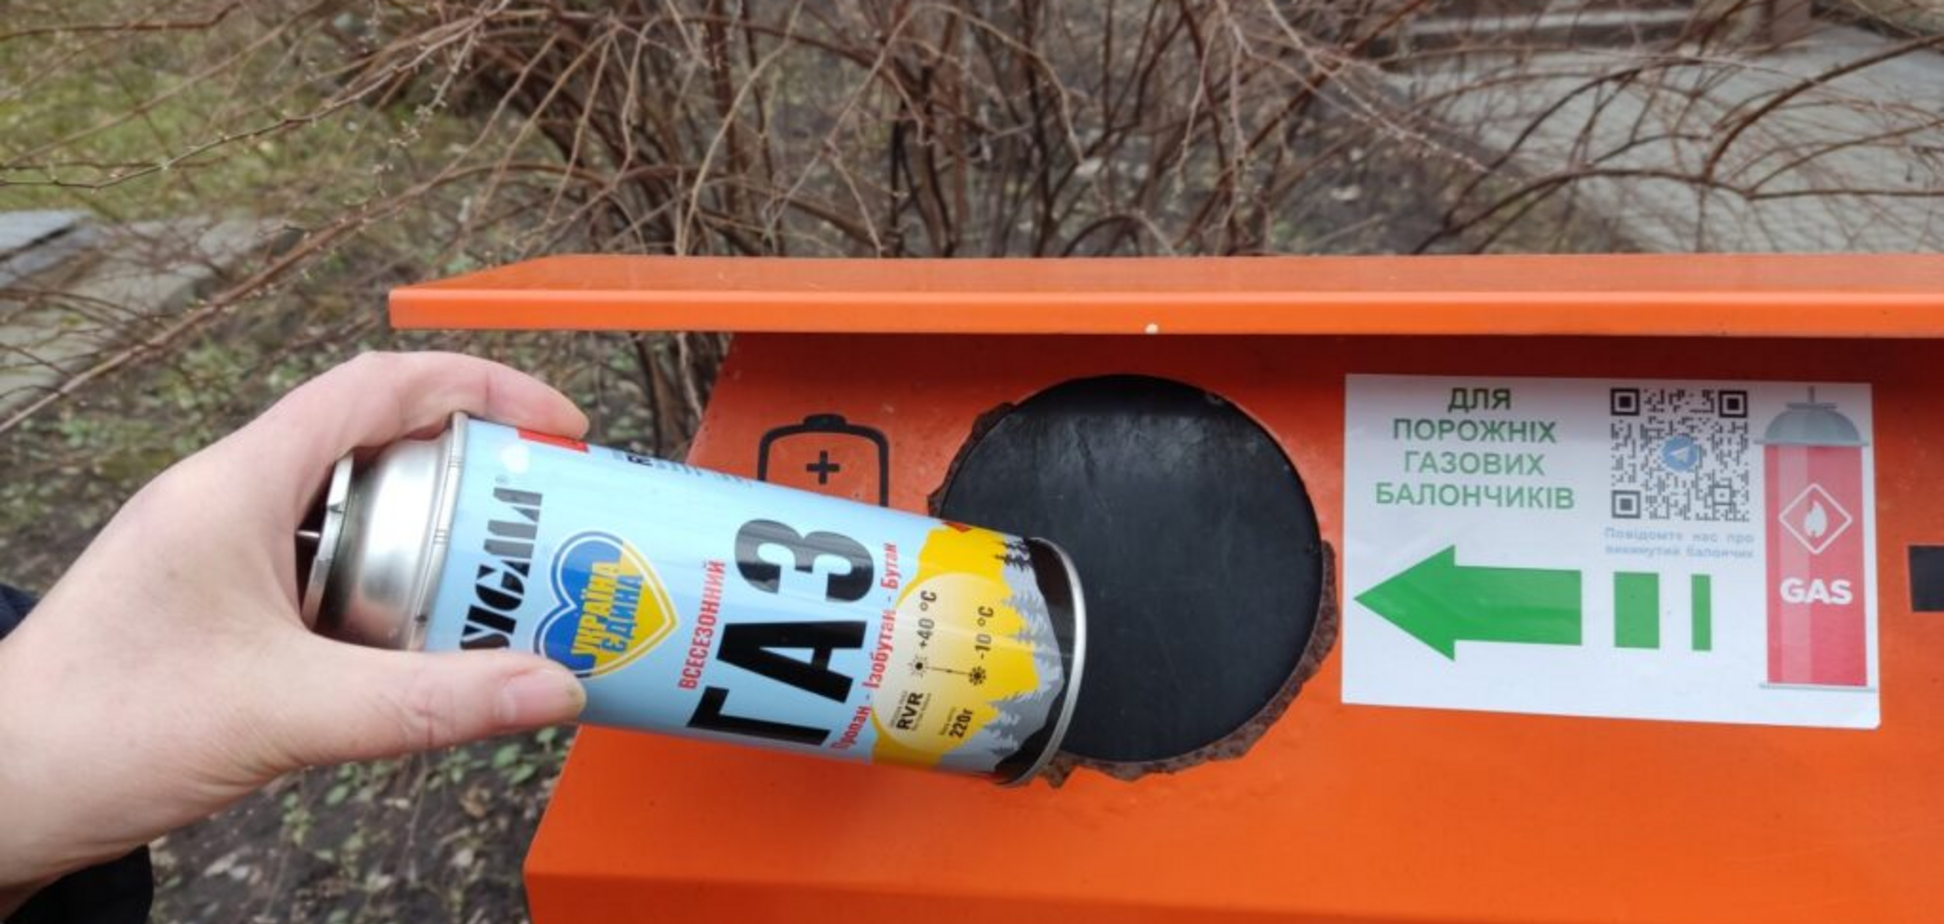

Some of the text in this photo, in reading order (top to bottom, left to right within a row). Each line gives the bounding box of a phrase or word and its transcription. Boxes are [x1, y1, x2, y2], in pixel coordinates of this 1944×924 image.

[1448, 387, 1511, 413] ДЛЯ
[1393, 418, 1556, 443] ПОРОЖНІХ
[1404, 450, 1545, 475] ГАЗОВИХ
[1375, 482, 1575, 509] БАЛОНЧИКІВ
[571, 561, 617, 655] УКРАЇНА
[1780, 578, 1853, 605] GAS
[600, 574, 643, 653] ЄДИНА
[677, 559, 726, 691] ВСЕСЕЗОННИЙ
[686, 518, 874, 746] ГАЗ
[831, 704, 873, 750] Пропан
[862, 608, 897, 689] Ізобутан
[880, 542, 901, 590] Бутан
[917, 616, 935, 649] +40
[974, 633, 993, 660] -10
[896, 691, 925, 731] RVR
